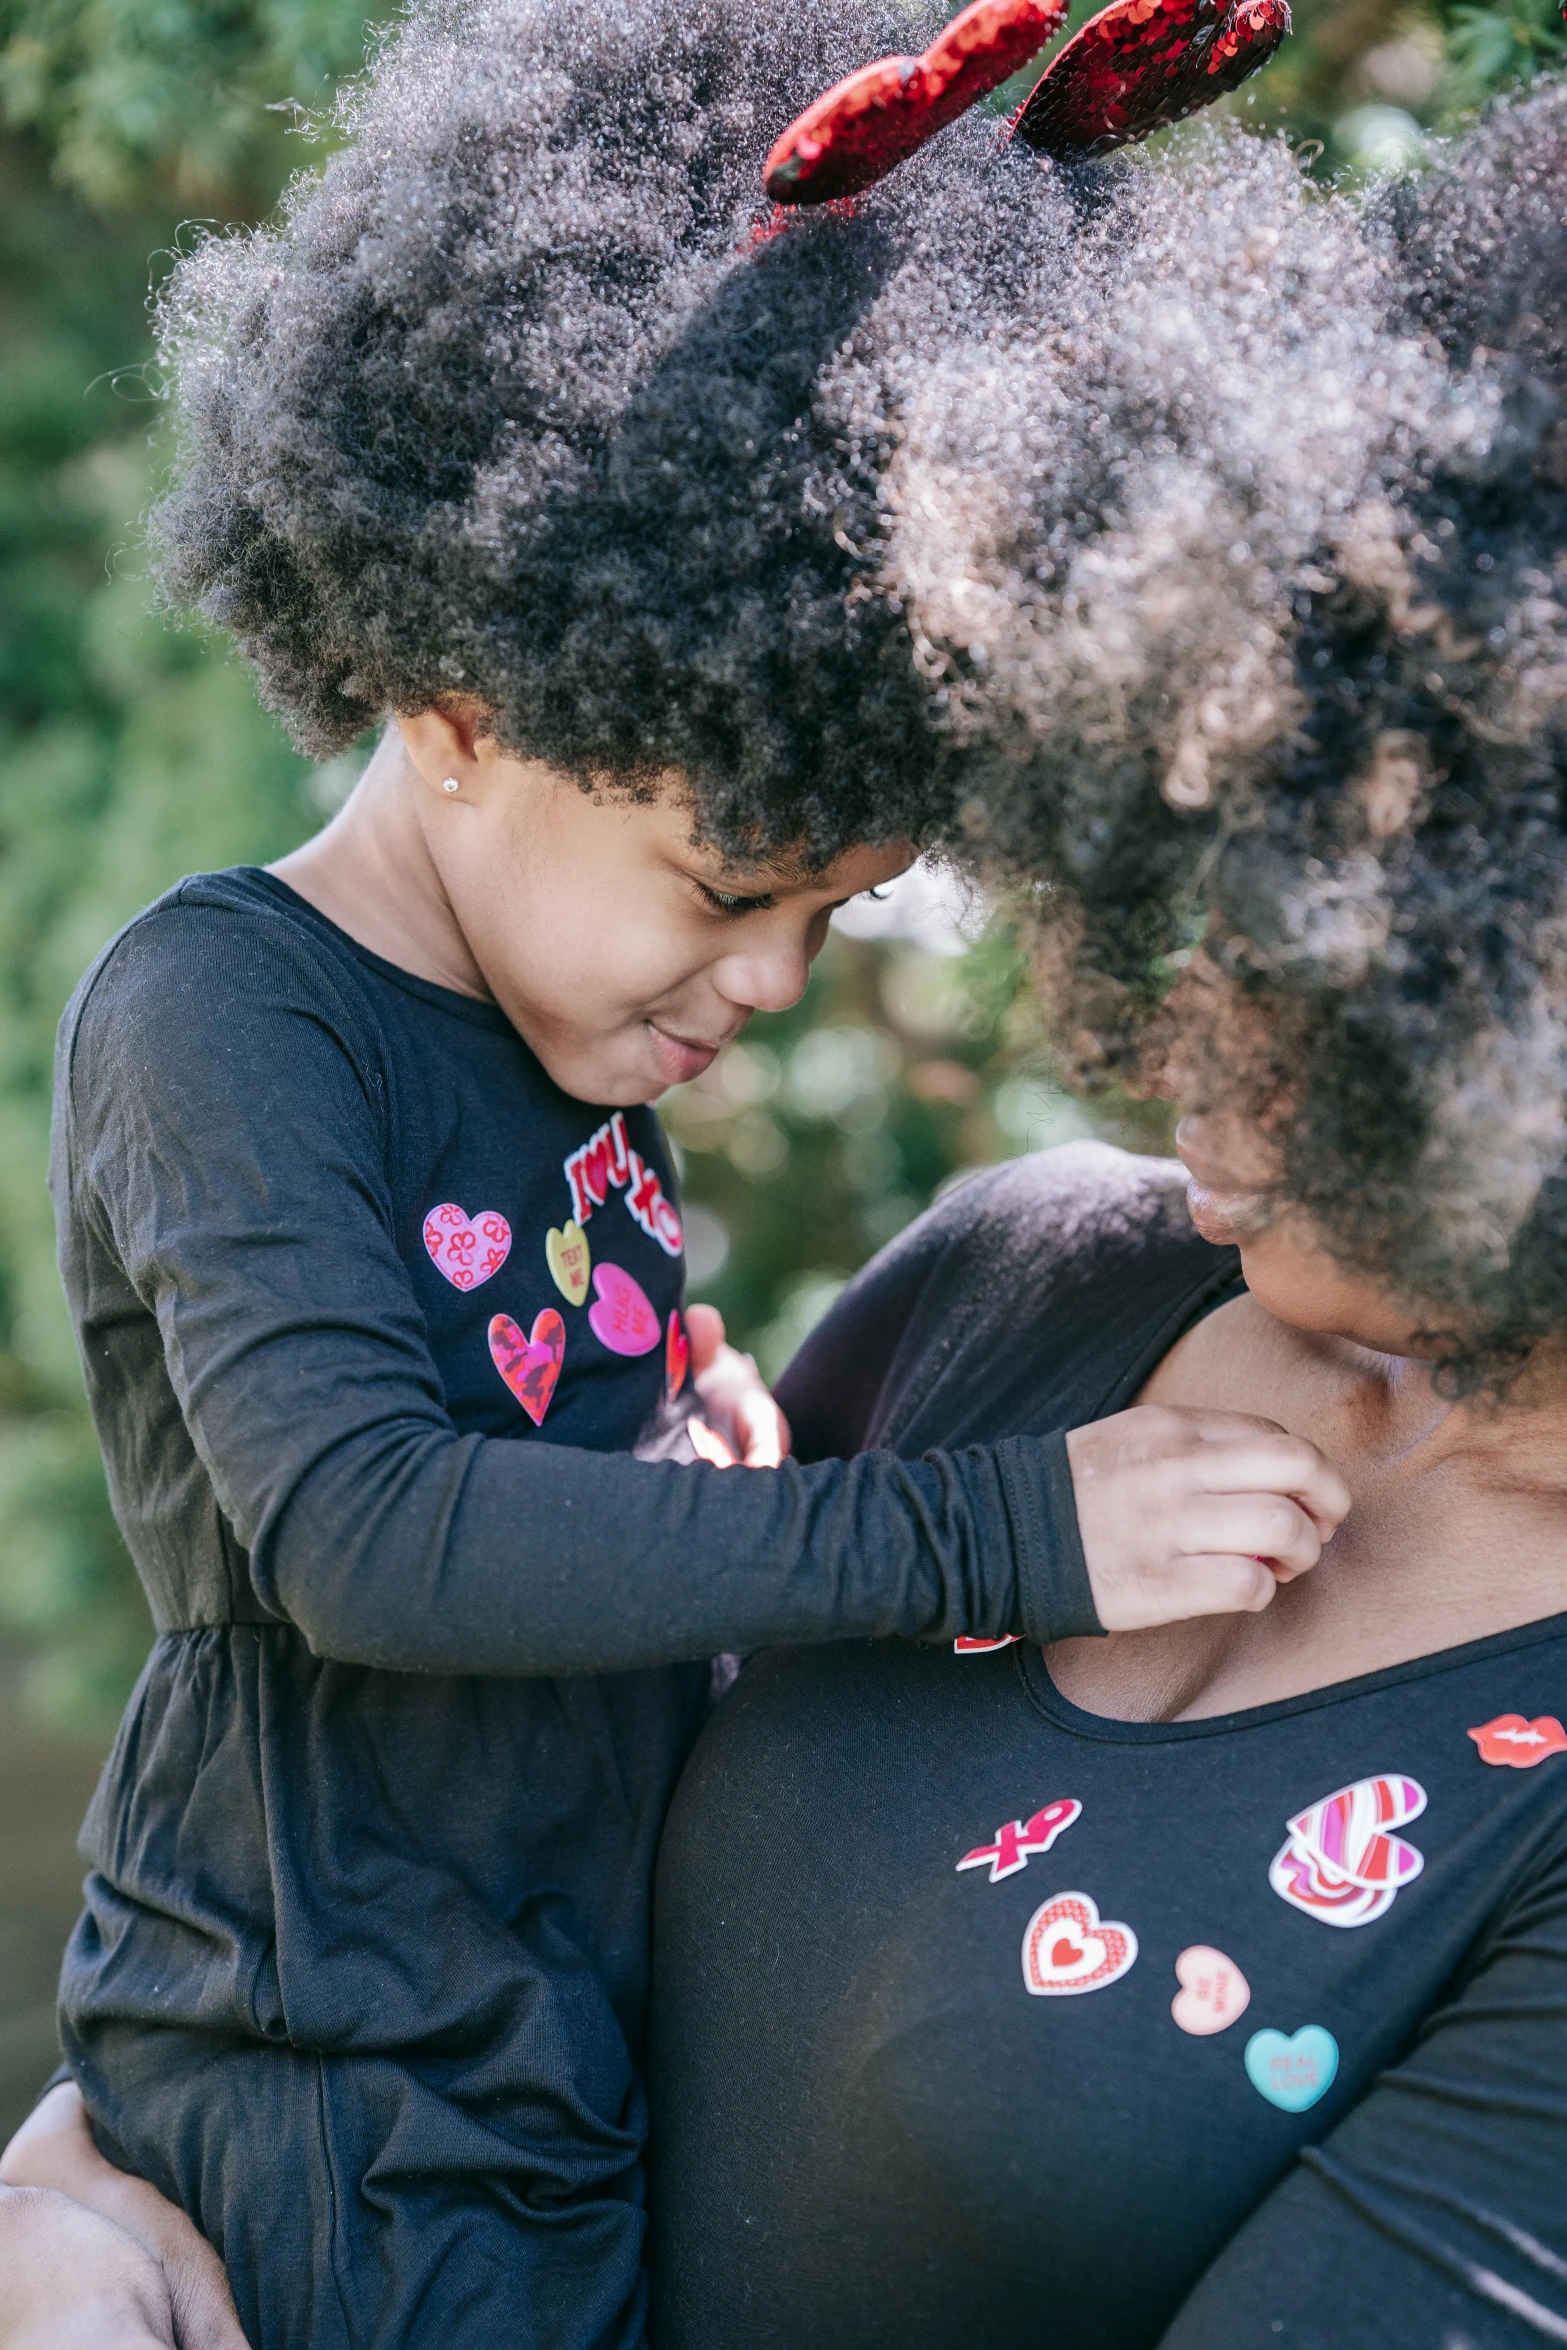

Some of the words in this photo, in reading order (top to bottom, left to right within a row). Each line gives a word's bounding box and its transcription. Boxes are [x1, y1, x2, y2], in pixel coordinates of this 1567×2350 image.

[560, 1244, 583, 1268] TEXT
[569, 1268, 584, 1289] ME
[612, 1284, 632, 1336] HUG
[632, 1303, 649, 1339] ME
[958, 1798, 1079, 1877] XO
[1213, 1969, 1230, 2014] MINE
[1269, 2053, 1318, 2071] REAL
[1271, 2072, 1321, 2091] LOVE
